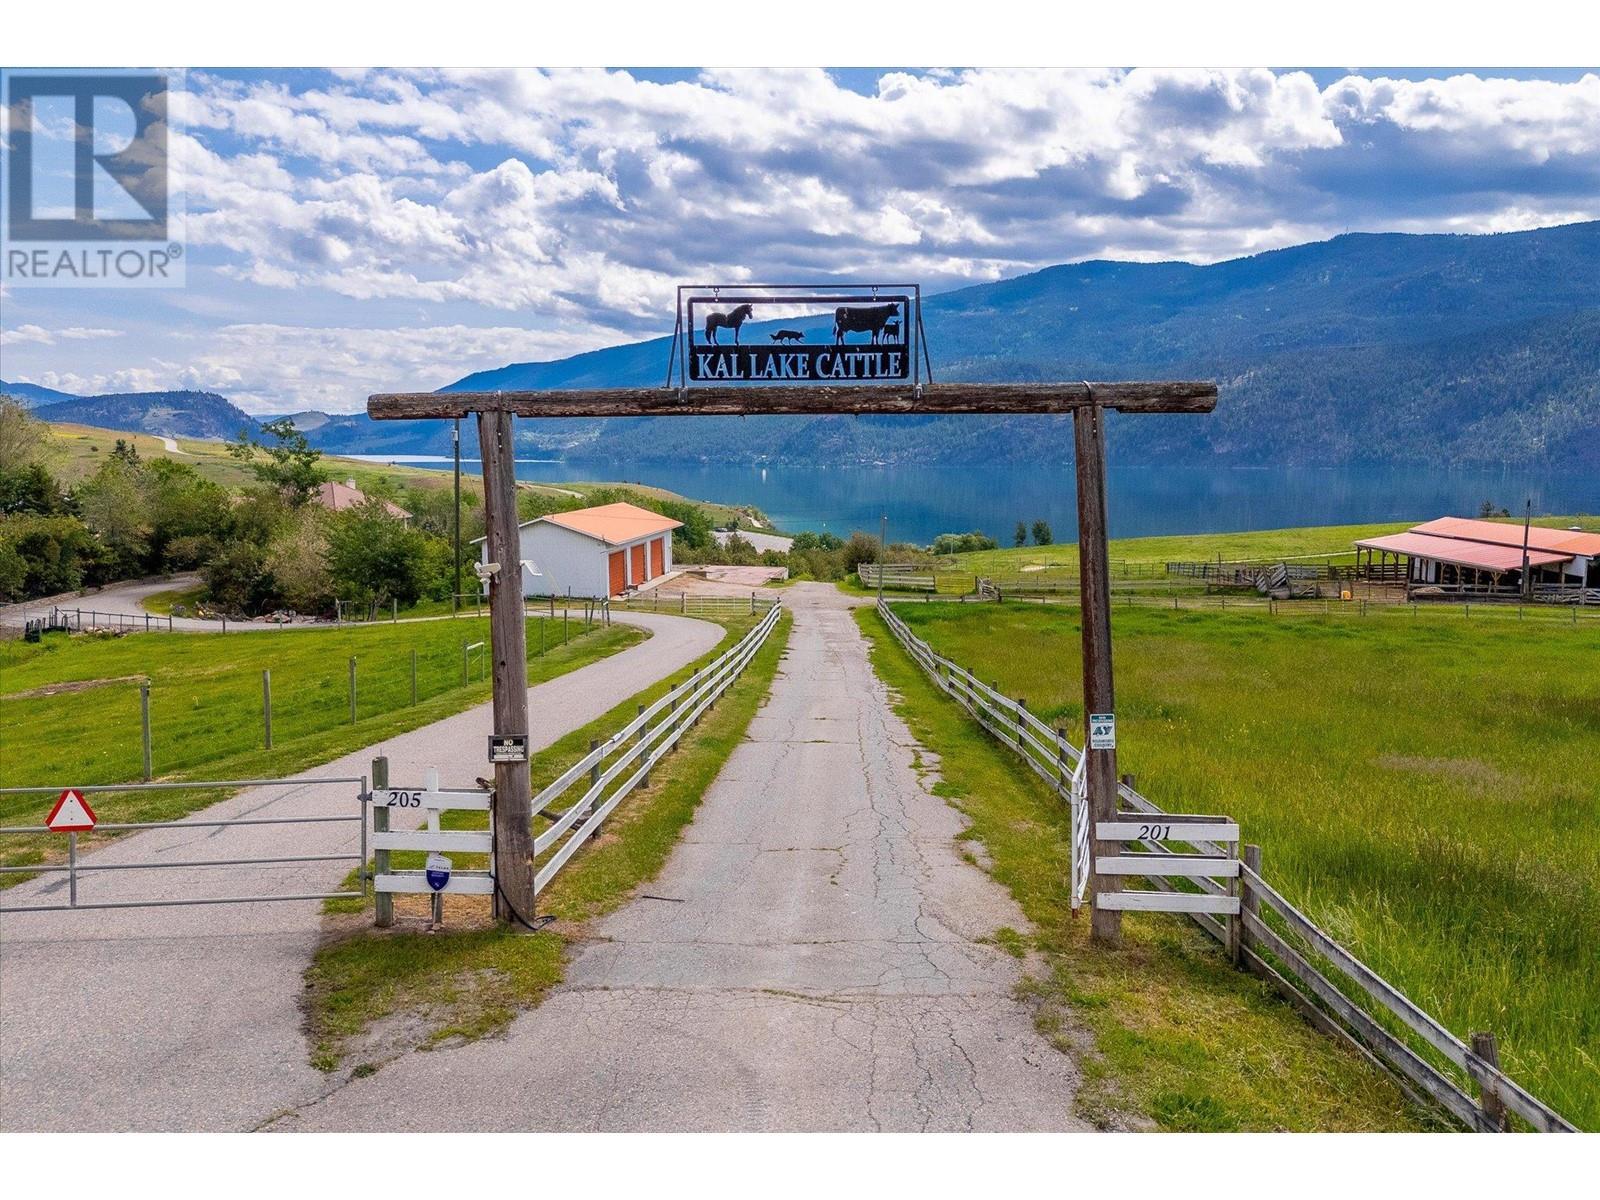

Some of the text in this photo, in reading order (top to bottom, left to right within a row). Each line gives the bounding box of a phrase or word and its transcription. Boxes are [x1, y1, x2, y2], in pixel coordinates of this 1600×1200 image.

[696, 352, 902, 379] KAL LAKE CATTLE
[386, 791, 421, 808] 205
[1137, 824, 1171, 840] 201
